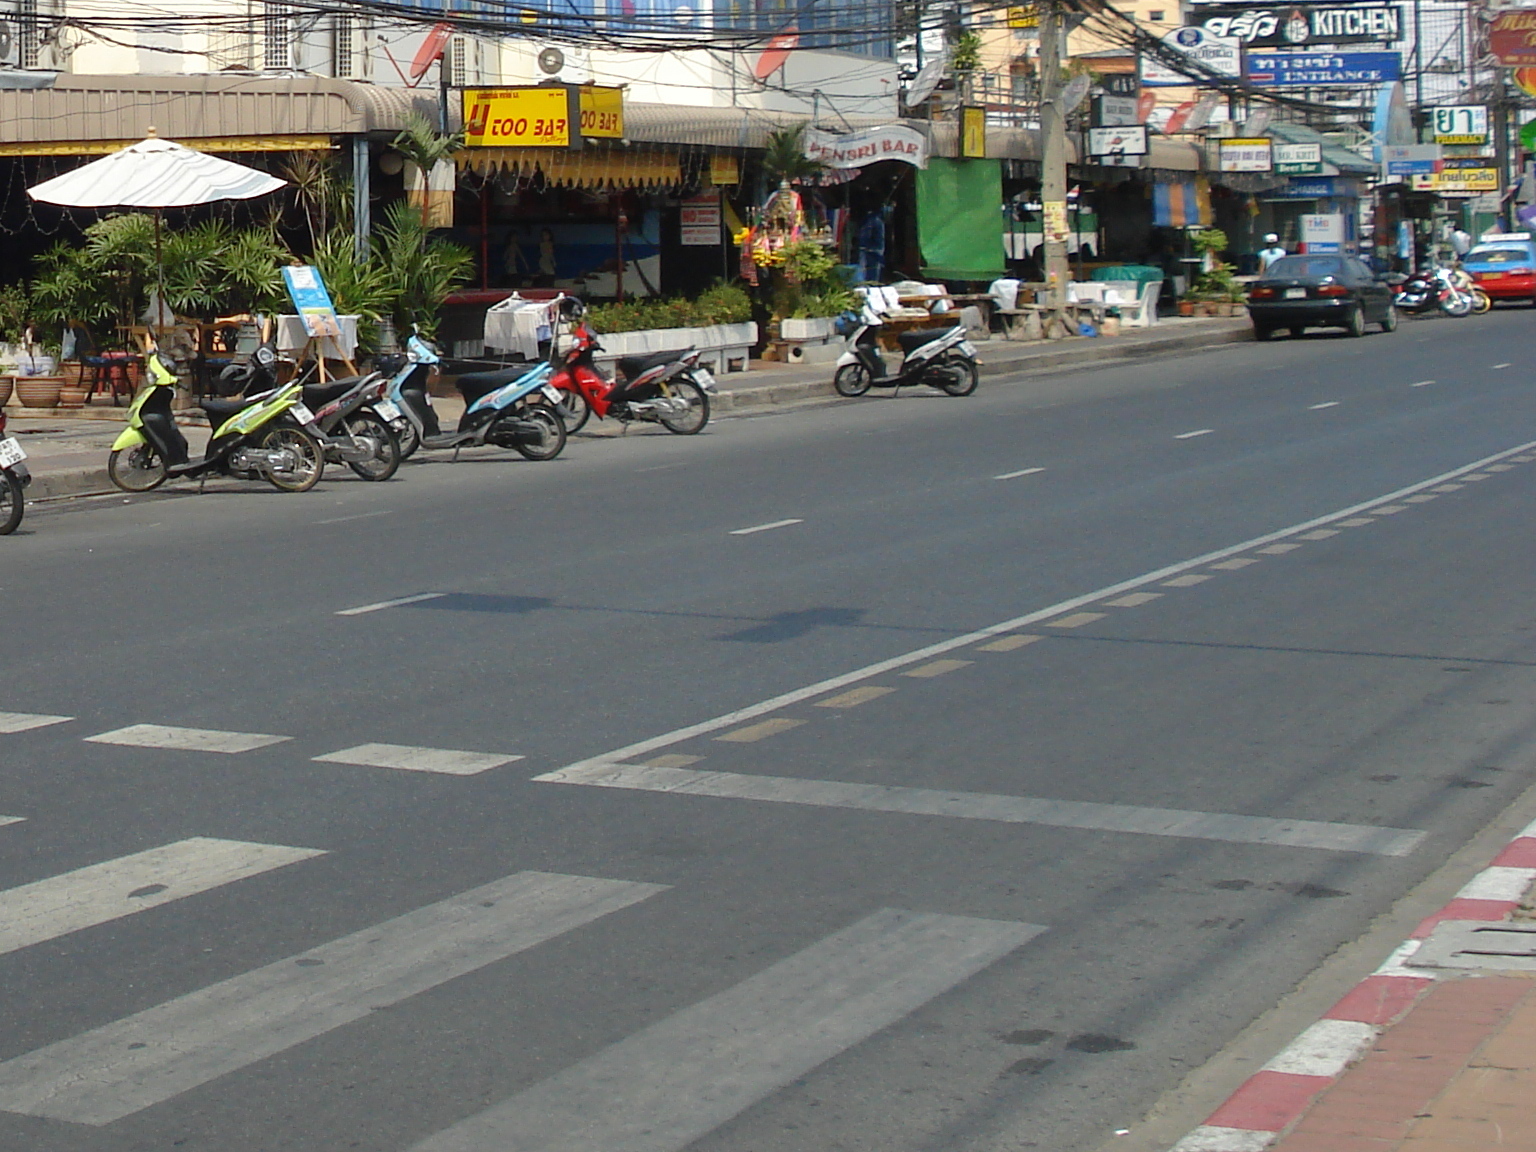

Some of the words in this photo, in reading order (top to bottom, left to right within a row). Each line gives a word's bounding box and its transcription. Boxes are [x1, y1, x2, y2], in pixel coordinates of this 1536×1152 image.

[1315, 8, 1397, 36] KITCHEN
[1284, 70, 1382, 82] ENTRANCE
[534, 118, 566, 136] BAR
[1436, 108, 1473, 133] ยา
[882, 139, 919, 154] BAR
